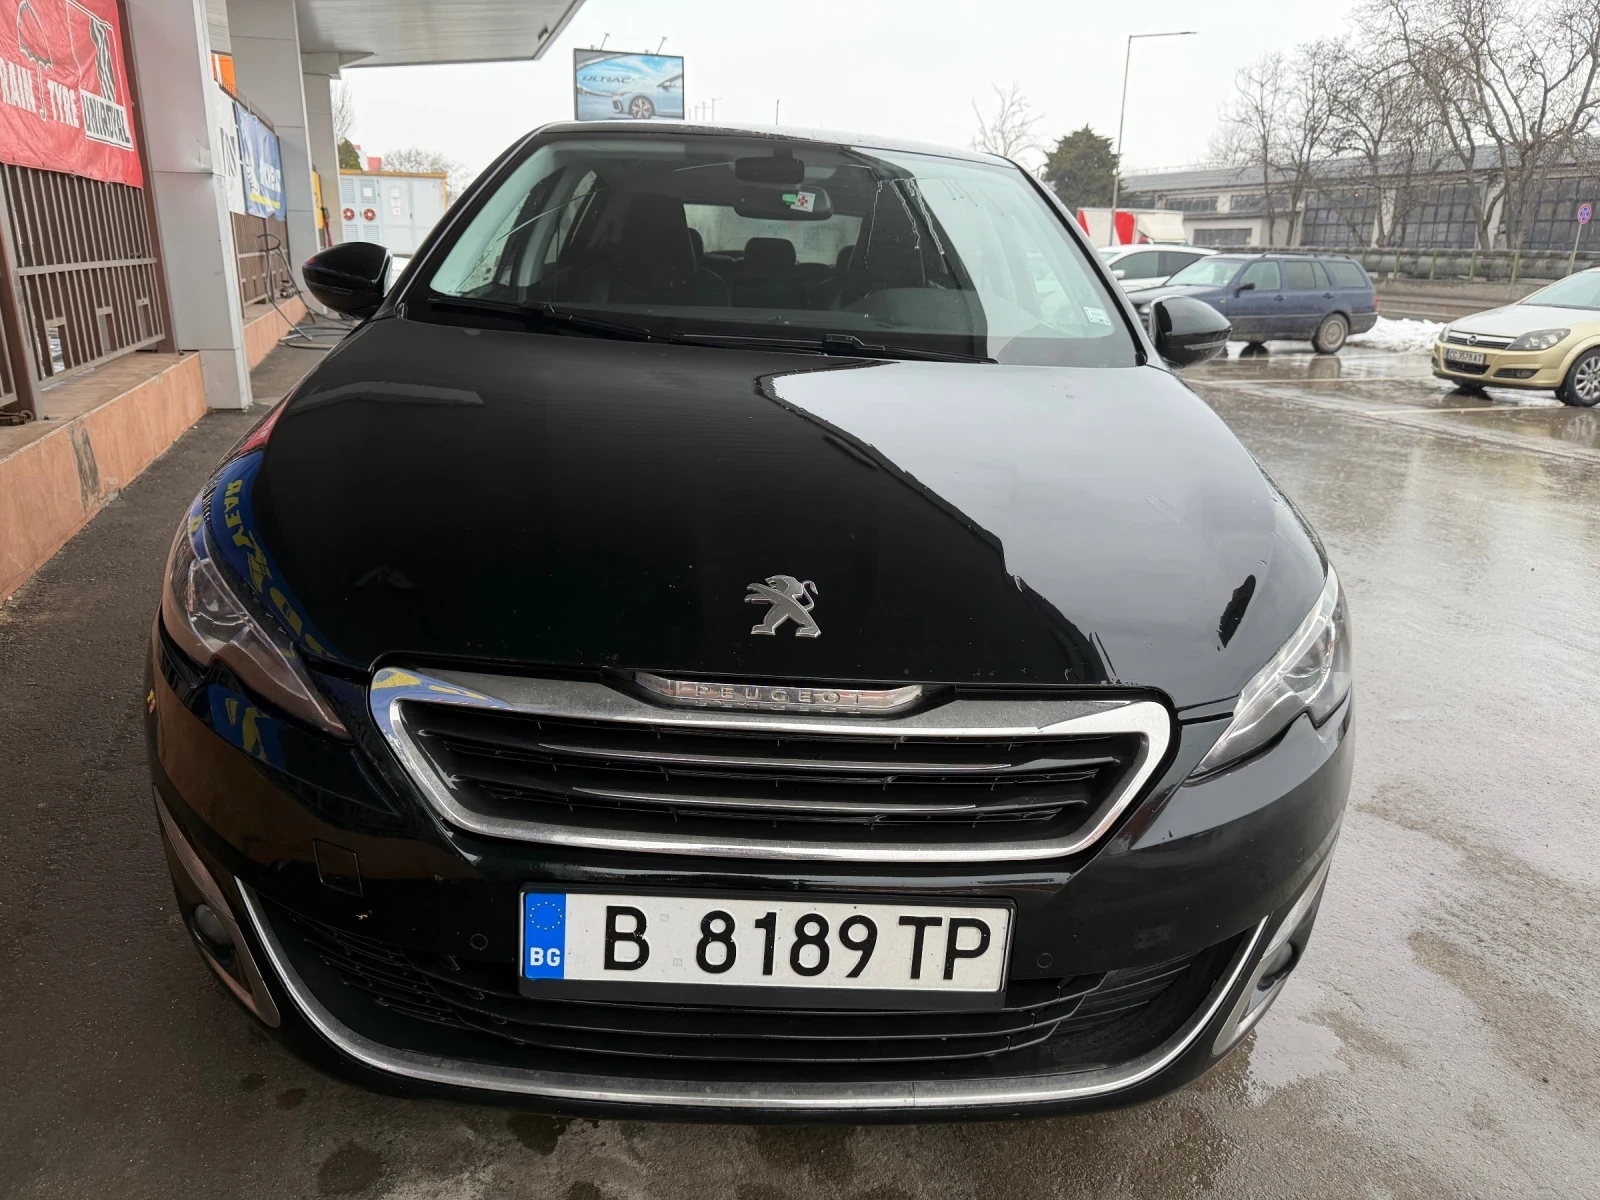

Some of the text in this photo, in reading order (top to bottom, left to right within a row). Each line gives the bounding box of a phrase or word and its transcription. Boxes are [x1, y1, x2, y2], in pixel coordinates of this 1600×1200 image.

[0, 56, 80, 128] RAIN TYRE
[81, 94, 131, 144] UNIROYAL
[695, 684, 864, 705] PEUGEOT
[529, 947, 561, 966] BG
[603, 905, 992, 980] B 8189 TP
